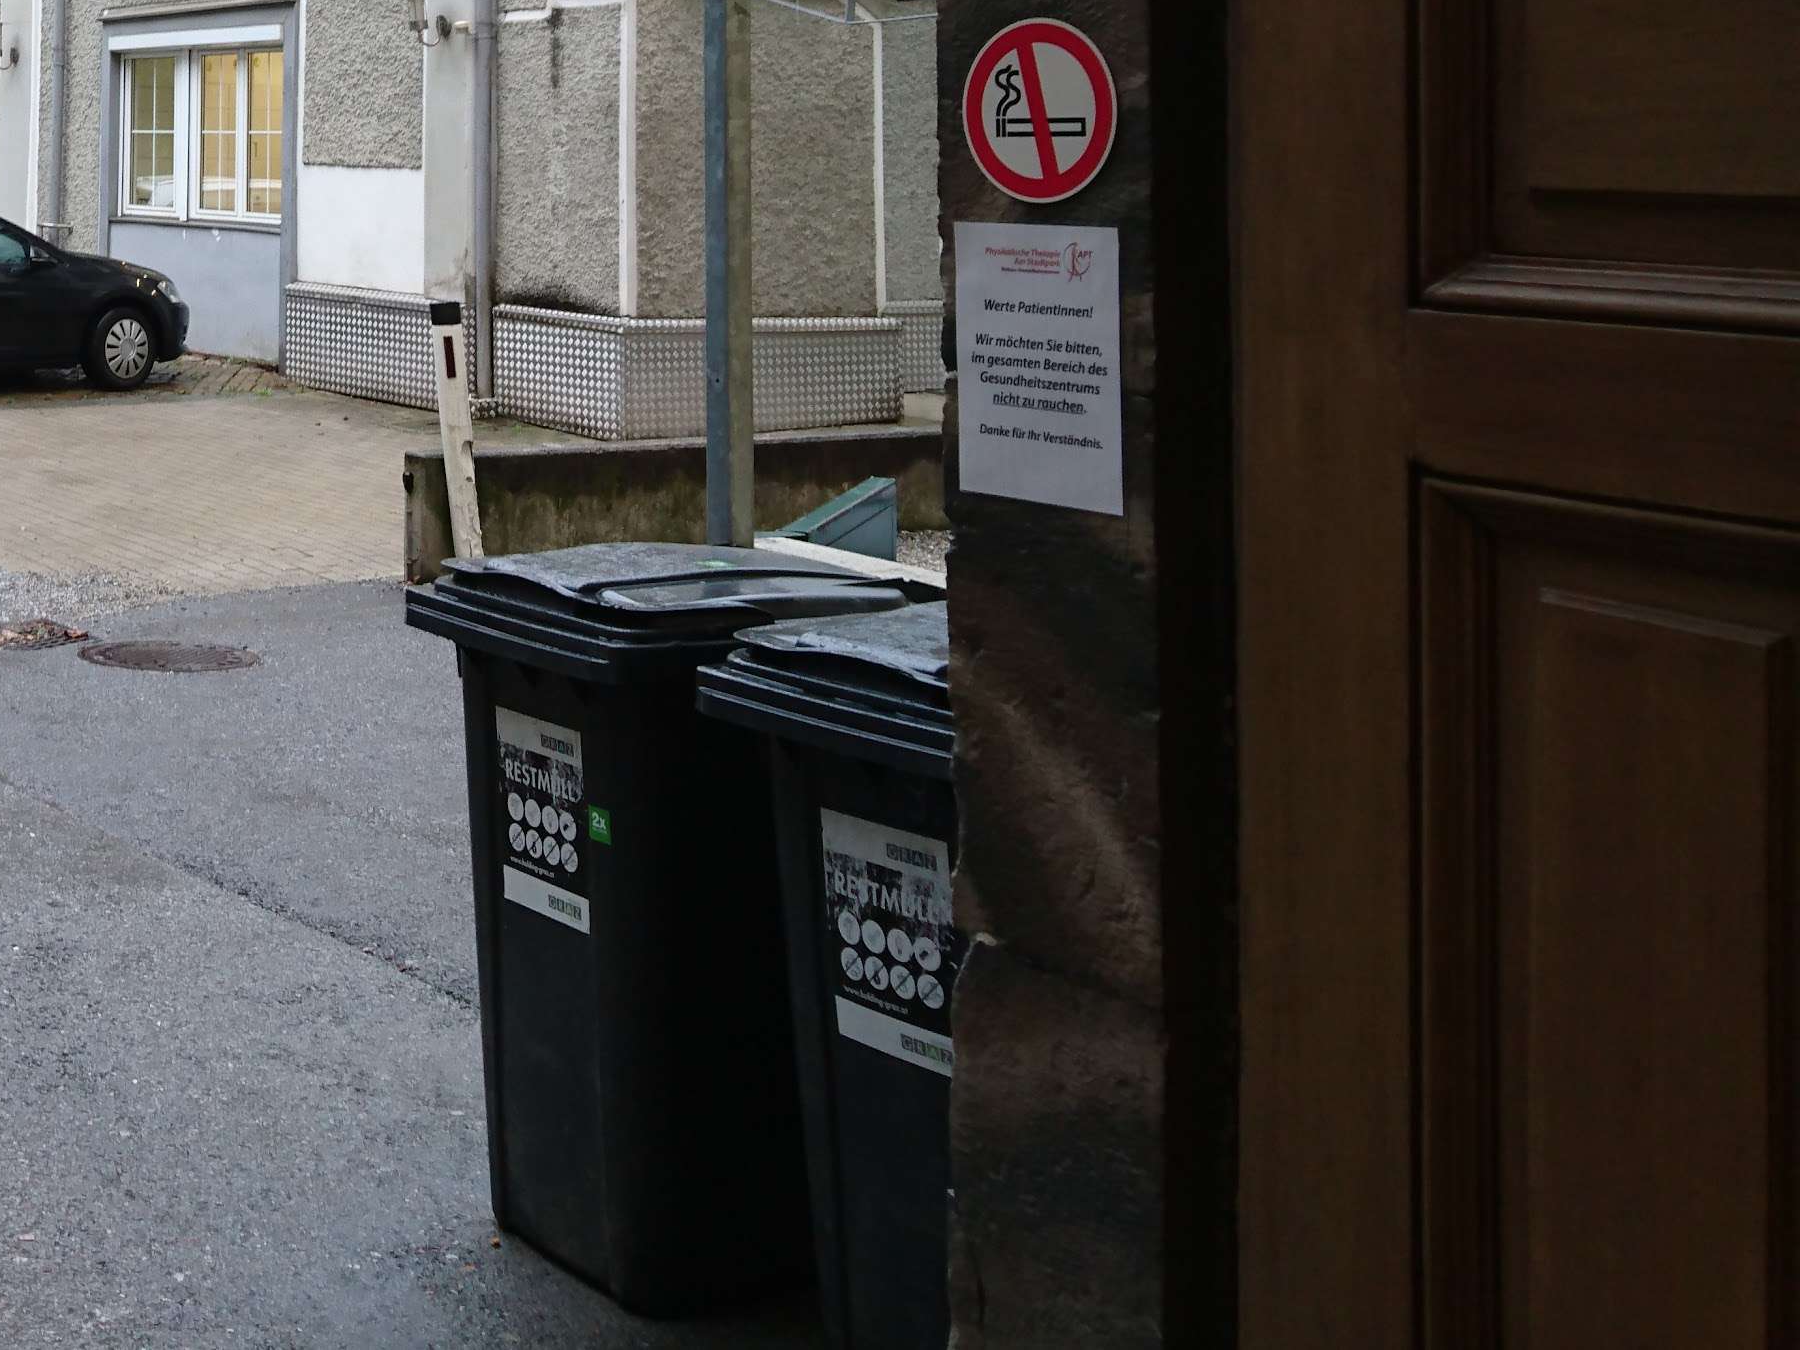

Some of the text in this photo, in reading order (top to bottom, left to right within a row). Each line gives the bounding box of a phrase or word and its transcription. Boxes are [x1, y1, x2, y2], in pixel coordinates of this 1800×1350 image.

[984, 299, 1016, 312] Werte
[976, 333, 1103, 357] Wir möchten Sie bitten,
[971, 352, 1109, 376] im gesamten Bereich des
[980, 371, 1101, 395] Gesundheitszentrums
[993, 391, 1087, 414] nicht zu rauchen.
[980, 423, 1103, 450] Danke für Ihr Verständnis.
[834, 868, 946, 926] RETMÜL
